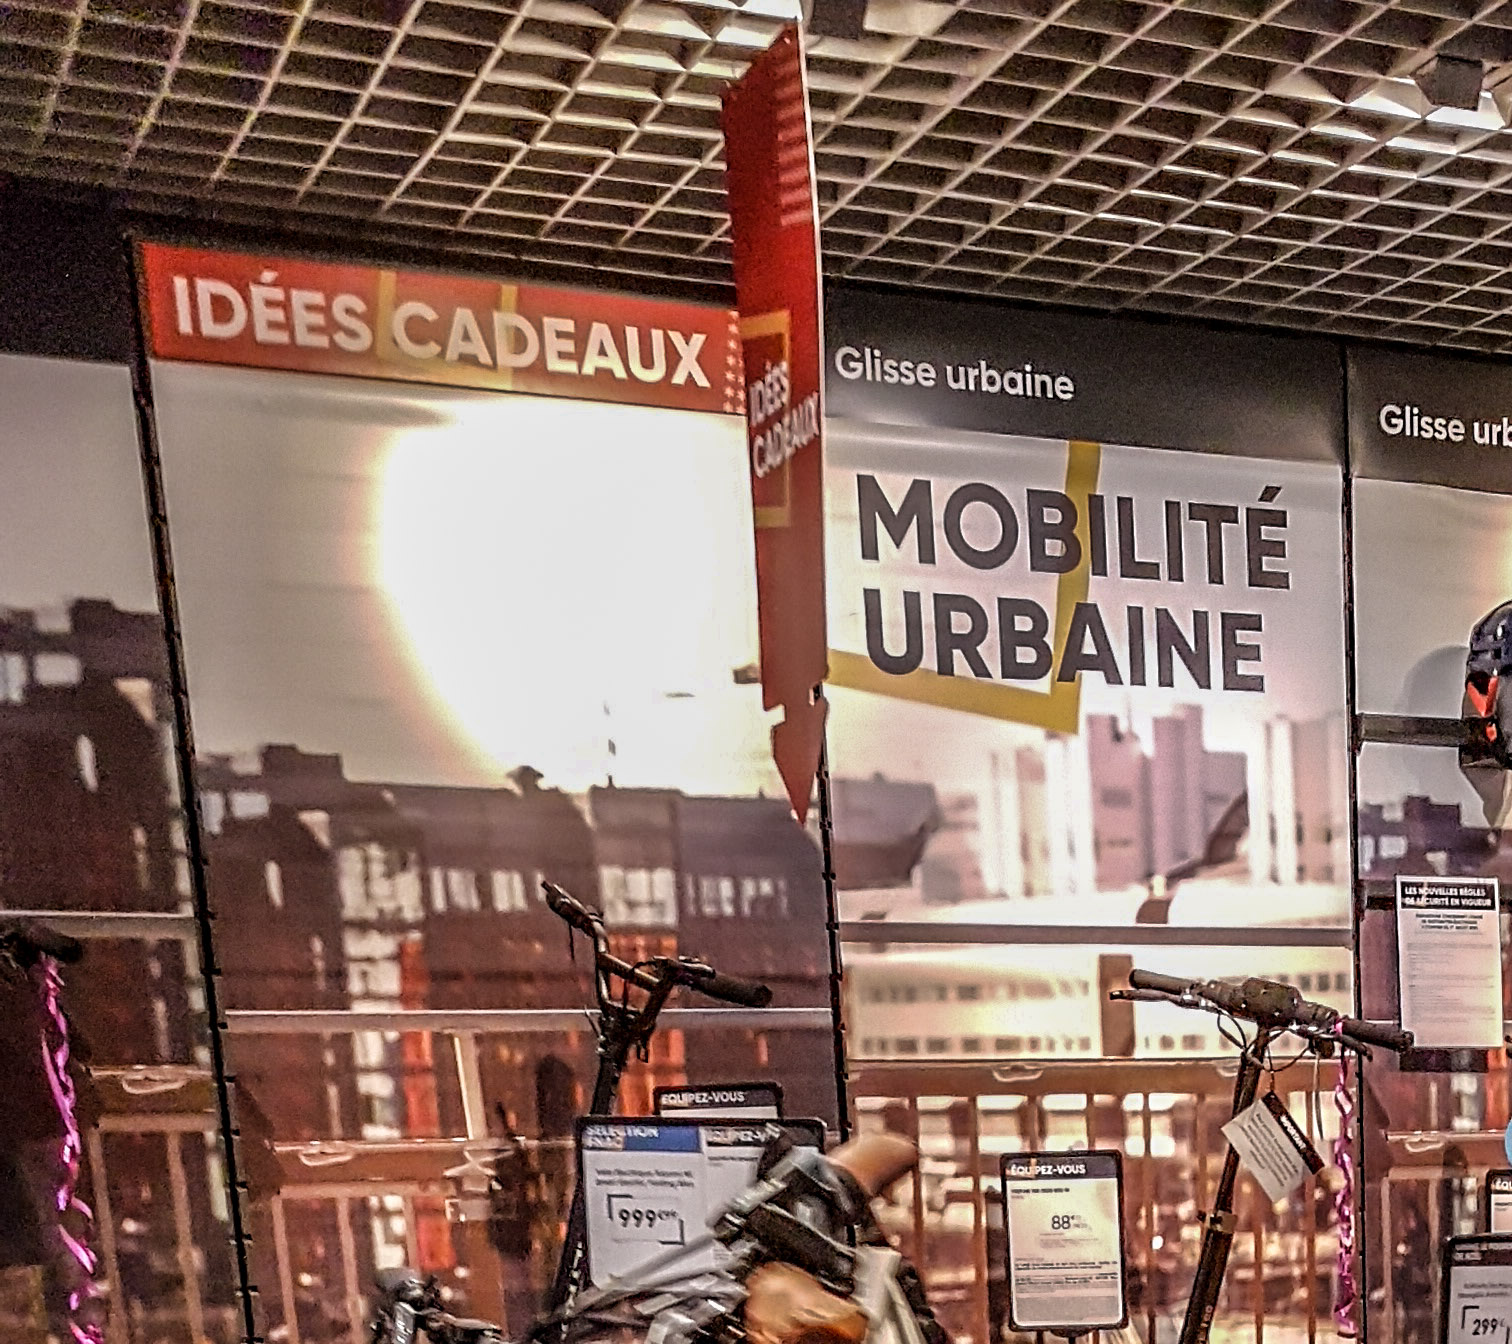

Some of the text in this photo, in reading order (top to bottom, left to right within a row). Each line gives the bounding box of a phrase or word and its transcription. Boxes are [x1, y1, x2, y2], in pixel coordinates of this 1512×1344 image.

[173, 270, 712, 389] IDÉES CADEAUX
[750, 361, 789, 427] IDÉES
[835, 346, 1075, 402] Glisse urbaine
[753, 391, 819, 479] CADEAUX
[1379, 404, 1466, 443] Glisse
[855, 473, 1291, 591] MOBILITÉ
[864, 587, 1266, 694] URBAINE
[1010, 1163, 1086, 1175] ÉQUIPEZ-VOUS
